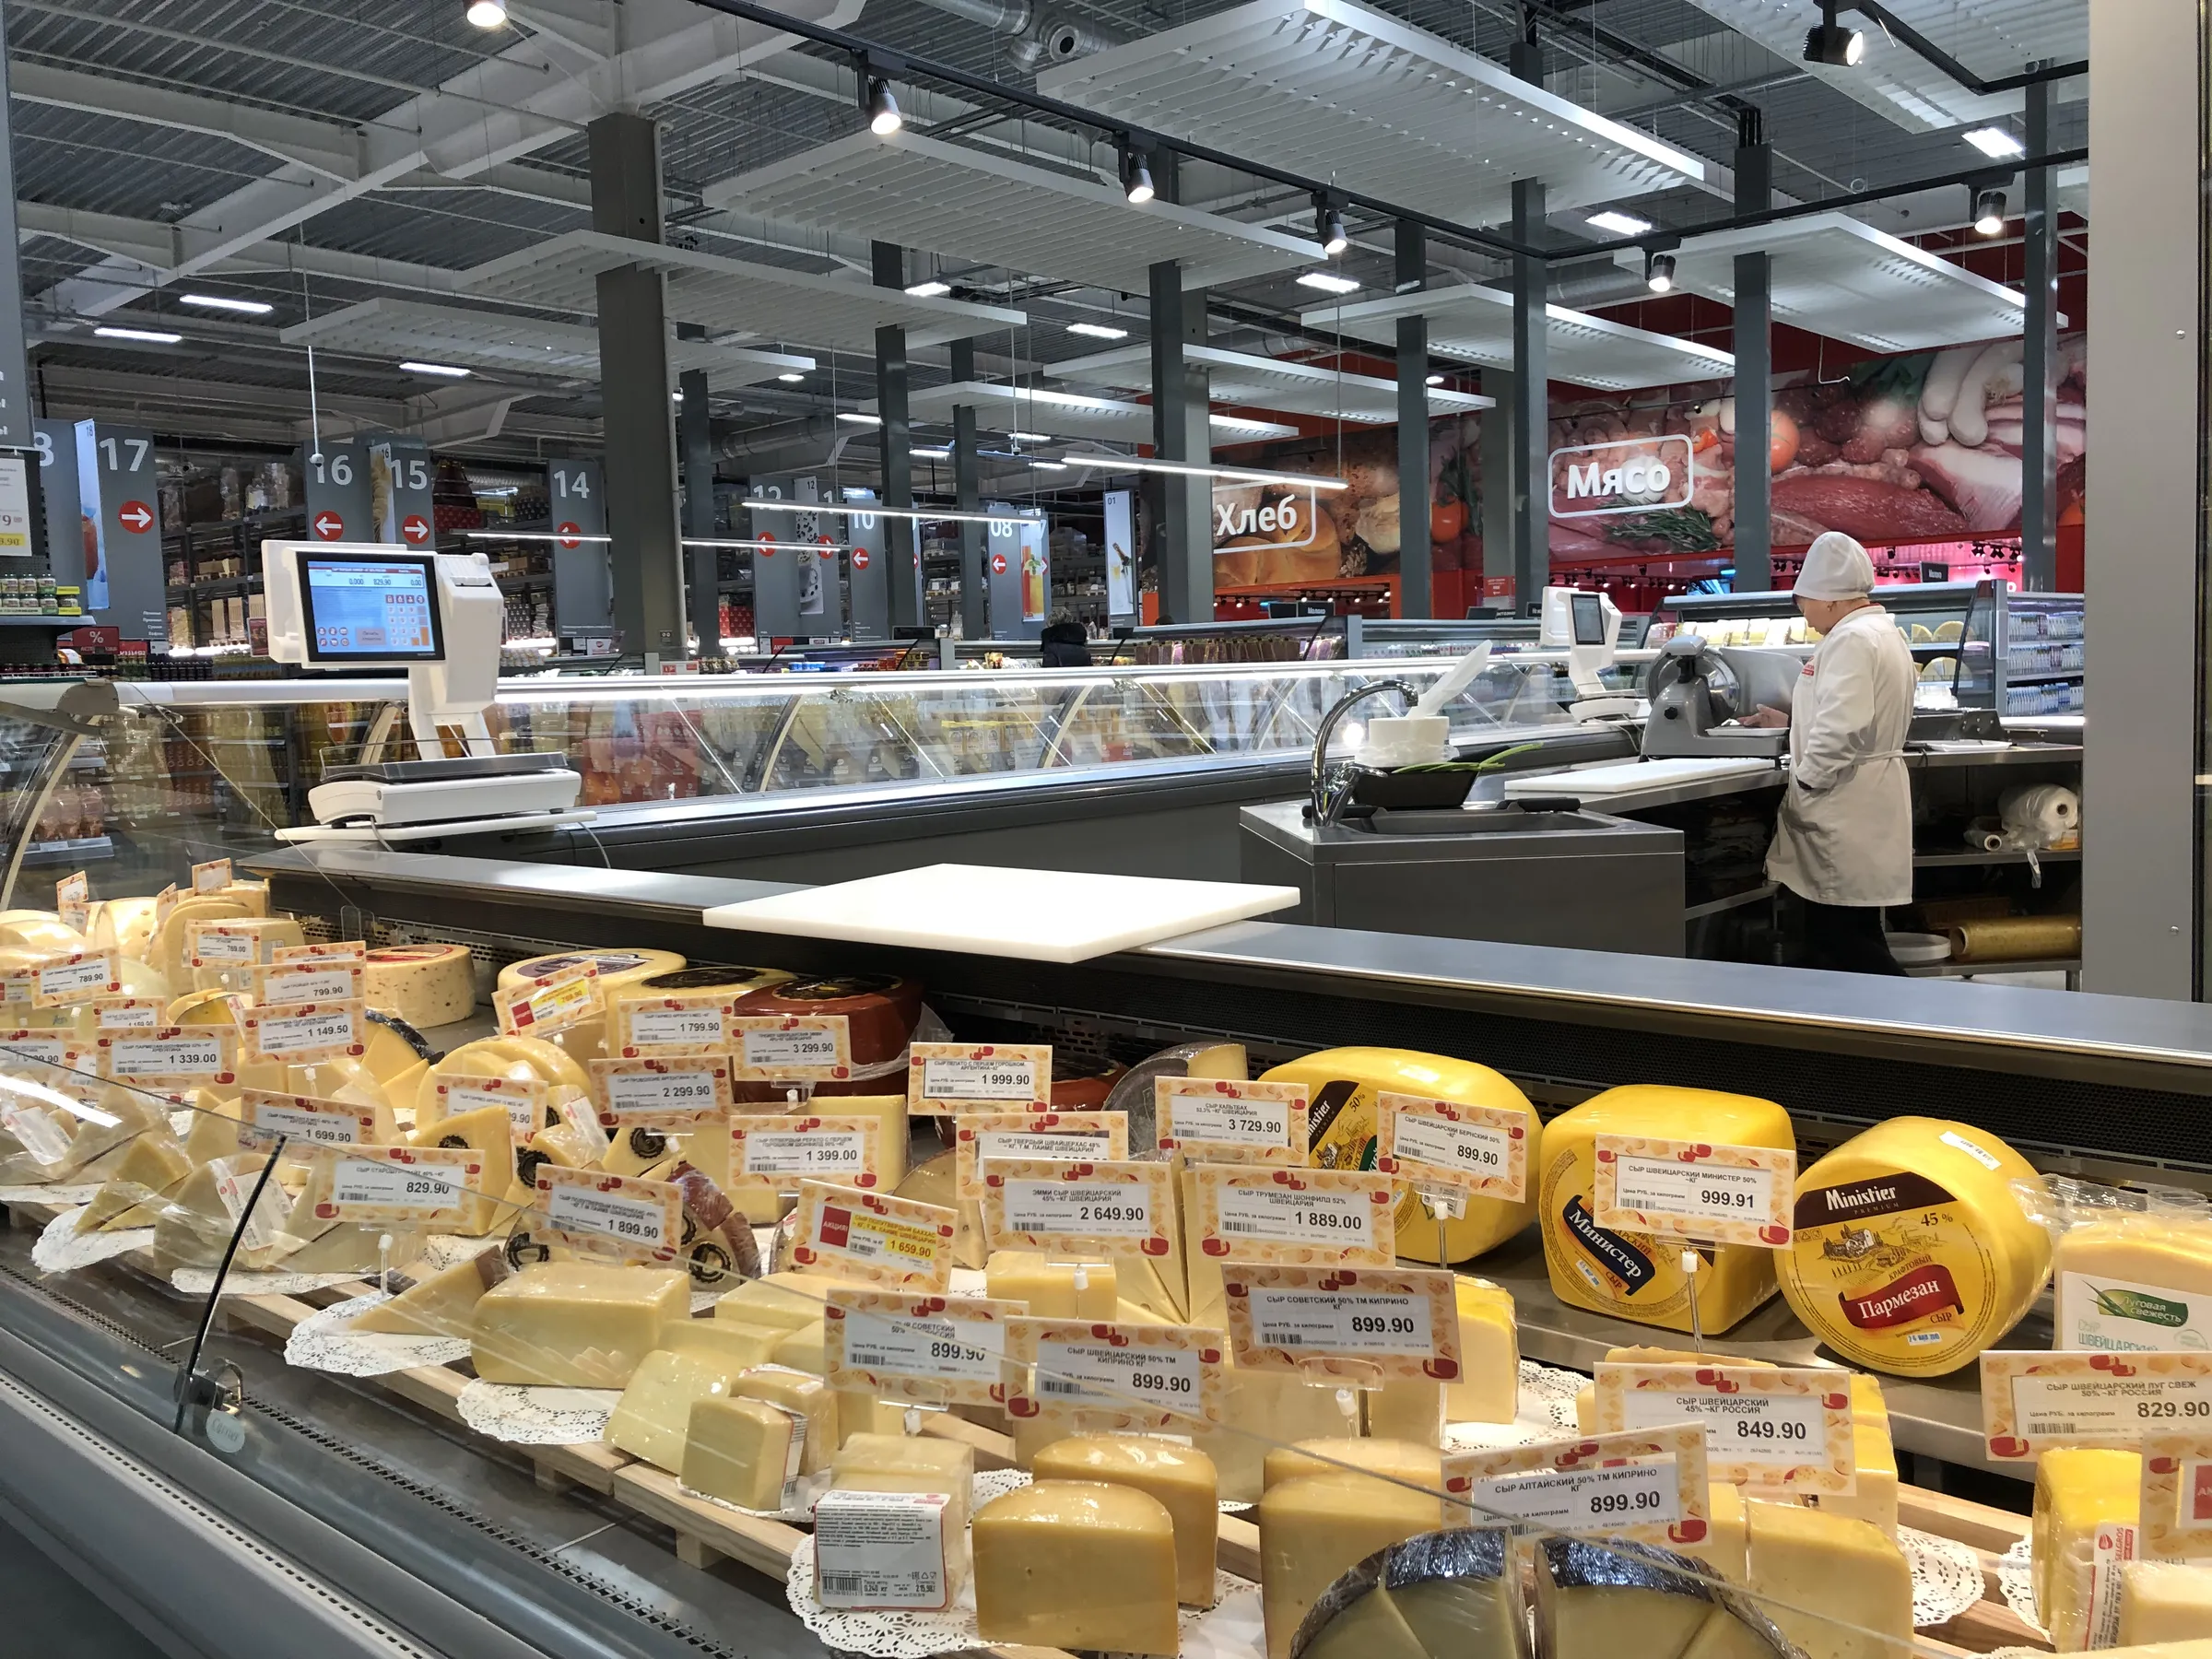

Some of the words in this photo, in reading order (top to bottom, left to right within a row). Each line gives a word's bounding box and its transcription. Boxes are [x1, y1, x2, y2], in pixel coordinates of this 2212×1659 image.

[100, 438, 148, 472] 17
[317, 455, 352, 485] 16
[390, 460, 427, 490] 15
[554, 470, 590, 499] 14
[807, 481, 815, 489] 12
[1568, 462, 1671, 499] Мясо
[853, 512, 875, 529] 10
[1217, 494, 1297, 535] Хлеб
[990, 520, 1012, 536] 08
[79, 973, 103, 982] 789.90
[313, 986, 343, 996] 799.90
[317, 1025, 347, 1035] 149.50
[688, 1022, 719, 1031] 799.90
[794, 1044, 799, 1053] 3
[802, 1043, 833, 1053] 299.90
[170, 1055, 174, 1064] 1
[180, 1054, 217, 1063] 339.00
[982, 1075, 987, 1084] 1
[992, 1075, 1030, 1085] 999.90
[663, 1088, 670, 1097] 2
[673, 1086, 710, 1097] 299.90
[1229, 1119, 1236, 1130] 3
[1240, 1120, 1281, 1133] 729.90
[306, 1129, 311, 1137] 1
[315, 1130, 351, 1142] 699.90
[1489, 1135, 1500, 1144] 50%
[806, 1150, 812, 1160] 1
[818, 1150, 857, 1160] 399.00
[1457, 1145, 1499, 1165] 899.90
[1701, 1172, 1741, 1182] МИНИСТЕР
[406, 1182, 450, 1194] 829.90
[1256, 1191, 1291, 1199] ТРУМЕЗАН
[1293, 1194, 1331, 1203] ШОНФИЛД
[1701, 1190, 1754, 1208] 999.91
[1825, 1185, 1896, 1211] Ministier
[1080, 1207, 1088, 1220] 2
[1094, 1207, 1144, 1220] 649.90
[1853, 1202, 1900, 1215] PREMIUM
[1295, 1212, 1302, 1224] 1
[1309, 1212, 1361, 1230] 889.00
[1921, 1213, 1938, 1227] 45
[608, 1219, 614, 1230] 1
[618, 1221, 658, 1238] 899.90
[890, 1240, 895, 1250] 1
[899, 1242, 931, 1257] 659.90
[1569, 1209, 1641, 1279] Министер
[1888, 1254, 1933, 1281] КРАФТОВЫЙ
[1606, 1271, 1623, 1289] СЫР
[1288, 1296, 1336, 1304] СОВЕТСКИЙ
[1858, 1280, 1941, 1319] Пармезан
[1930, 1312, 1952, 1324] СЫР
[2130, 1307, 2182, 1323] свежесть
[1352, 1317, 1414, 1333] 899.90
[1098, 1358, 1135, 1366] КИПРИНО
[1147, 1355, 1163, 1363] 50%
[1165, 1356, 1176, 1364] ТМ
[1132, 1373, 1191, 1393] 899.90
[2071, 1382, 2145, 1390] ШВЕЙЦАРСКИЙ
[2168, 1381, 2196, 1389] СВЕЖ
[1700, 1397, 1769, 1406] ШВЕЙЦАРСКИЙ
[2136, 1401, 2210, 1418] 829.90
[1737, 1420, 1806, 1440] 849.90
[1495, 1485, 1516, 1494] СЫР
[1519, 1478, 1575, 1490] АЛТАЙСКИЙ
[1577, 1477, 1595, 1485] 50%
[1613, 1469, 1657, 1480] КИПРИНО
[1591, 1491, 1660, 1513] 899.90
[1531, 1509, 1569, 1517] килограмм
